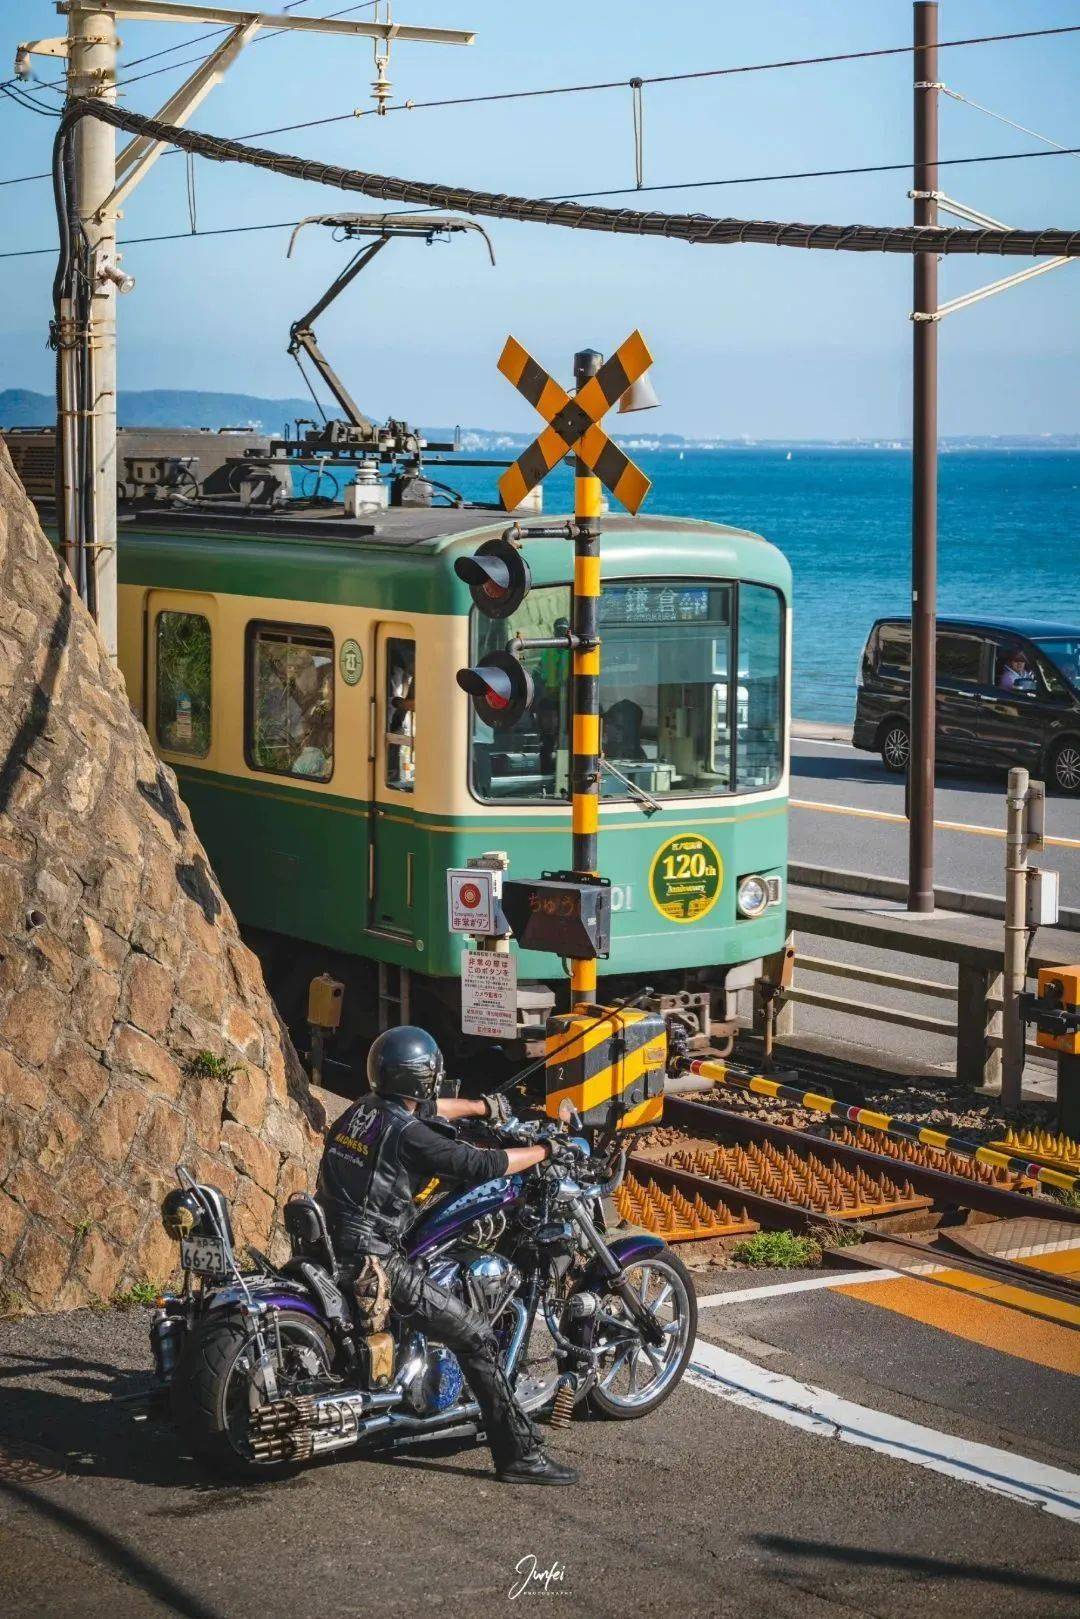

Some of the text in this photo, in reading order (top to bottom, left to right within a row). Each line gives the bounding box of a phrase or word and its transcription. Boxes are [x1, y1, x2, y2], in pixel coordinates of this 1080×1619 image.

[624, 586, 678, 612] 鎌倉
[453, 917, 489, 928] 非常ボタン
[468, 966, 510, 977] このボタンを
[558, 1066, 565, 1081] 2
